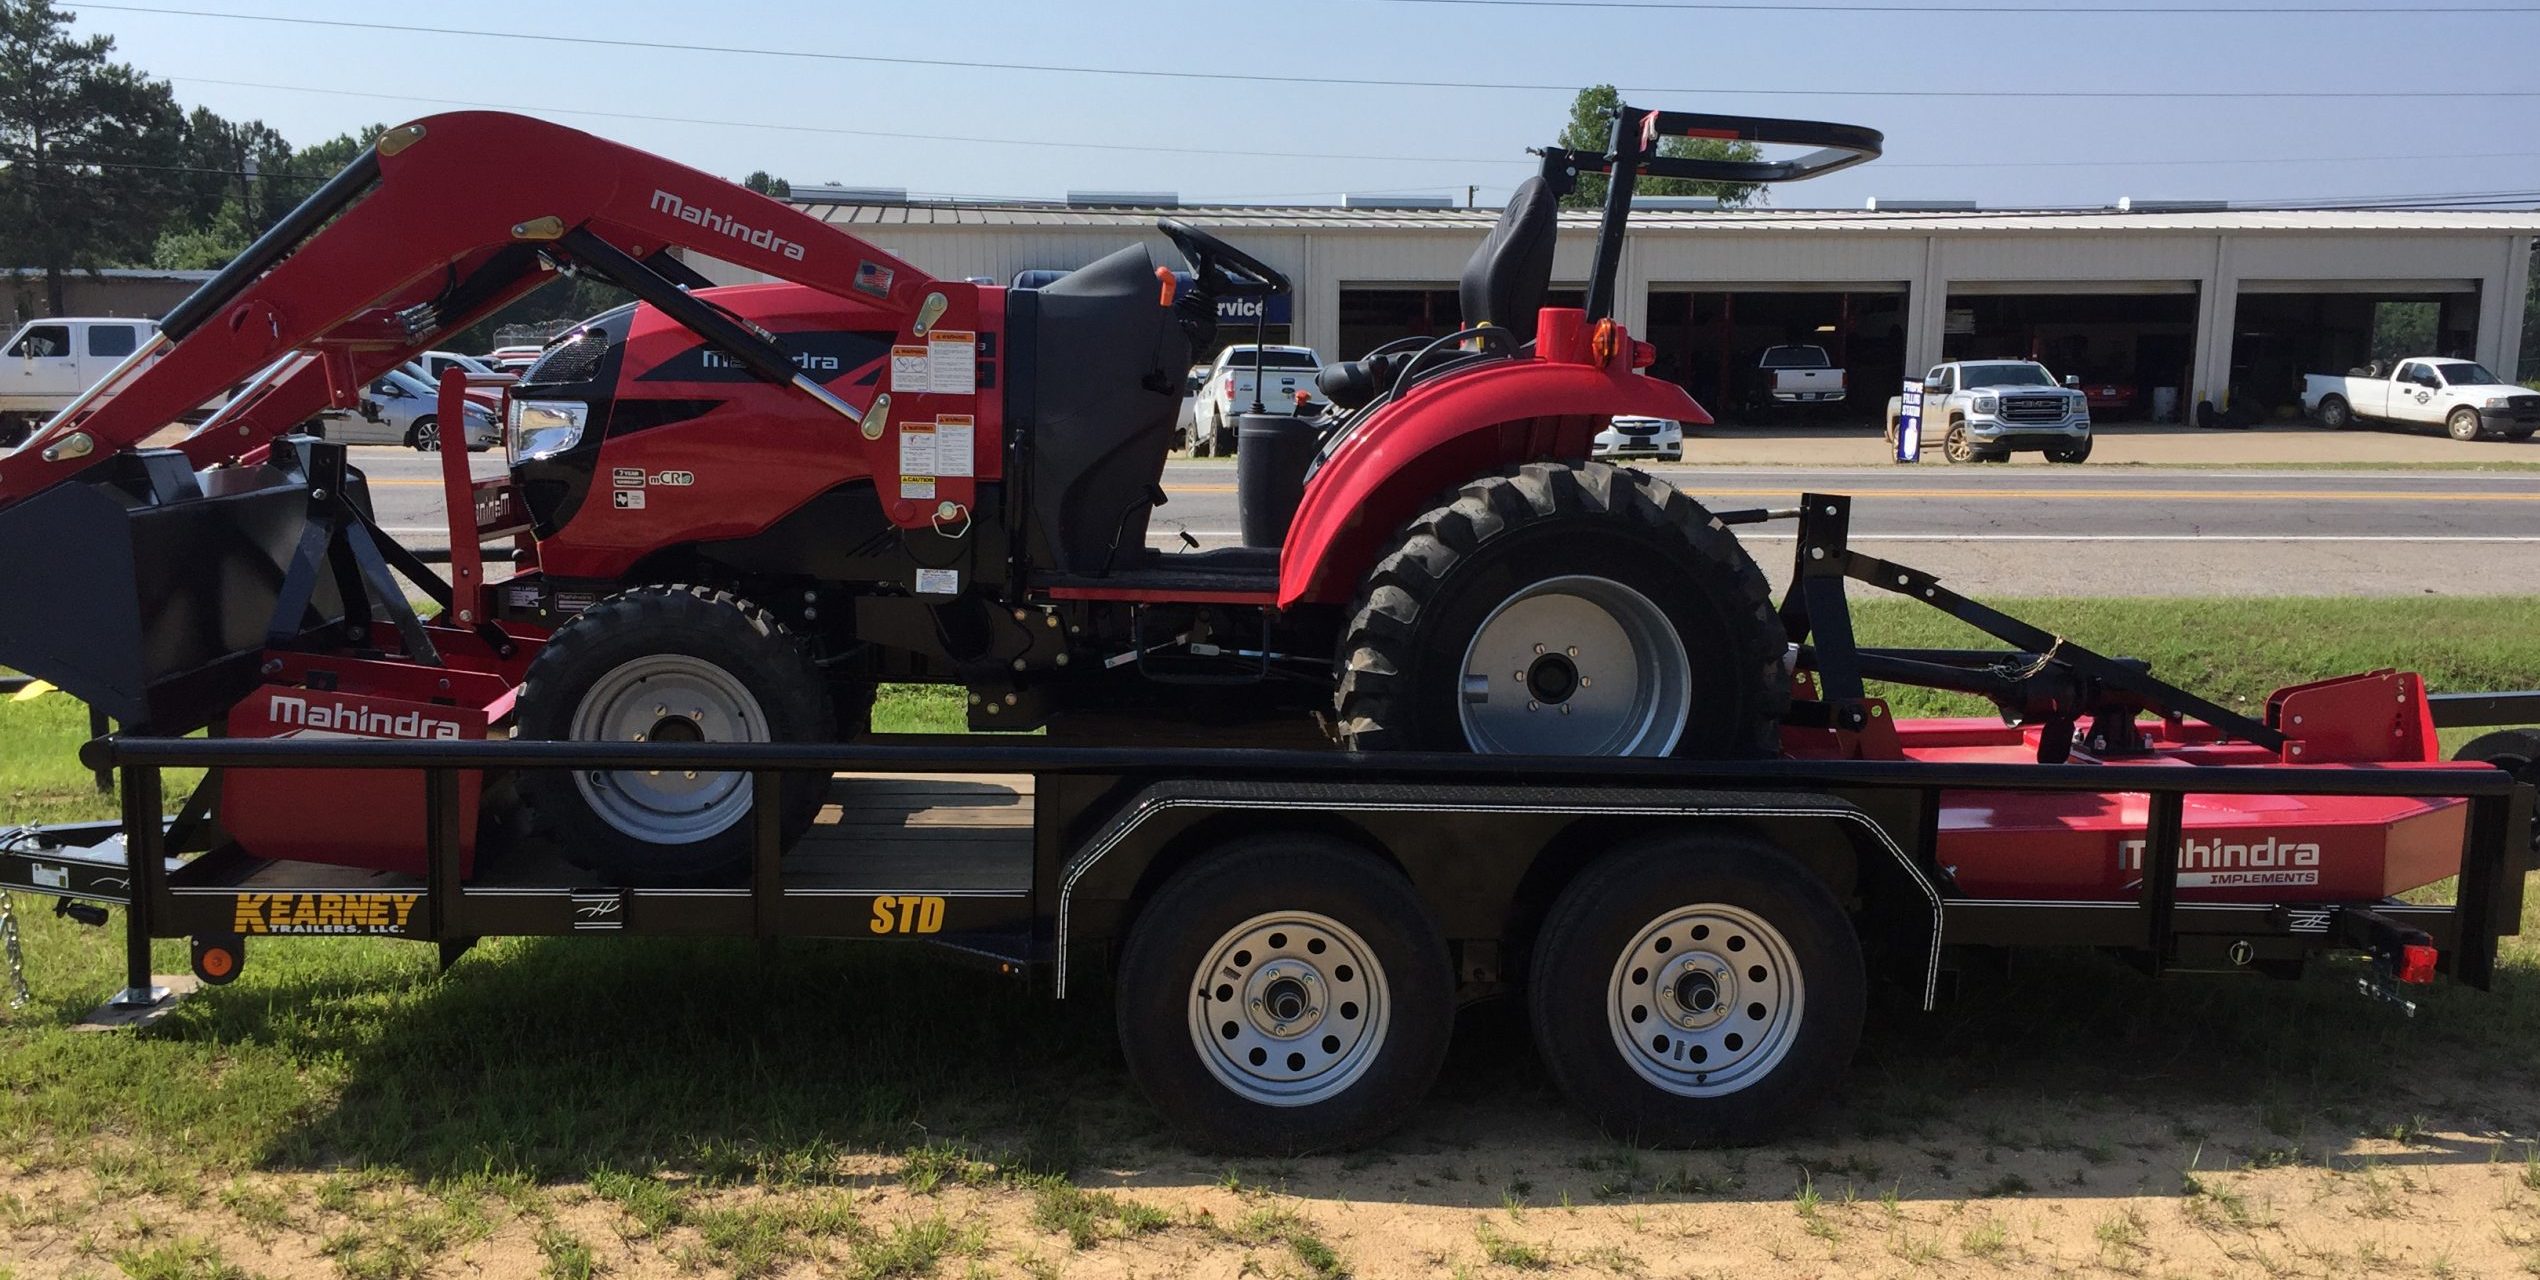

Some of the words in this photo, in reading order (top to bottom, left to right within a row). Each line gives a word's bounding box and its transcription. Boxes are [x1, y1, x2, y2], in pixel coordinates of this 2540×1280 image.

[651, 189, 805, 261] Mahindra
[1217, 298, 1268, 316] rvice
[270, 695, 460, 741] Mahindra
[2118, 837, 2320, 870] Mhindra
[2210, 872, 2316, 885] IMPLEMENTS
[234, 893, 418, 933] KEARNEY
[270, 924, 362, 934] TRAILERS,
[369, 925, 406, 933] LLC.
[870, 896, 946, 934] STD
